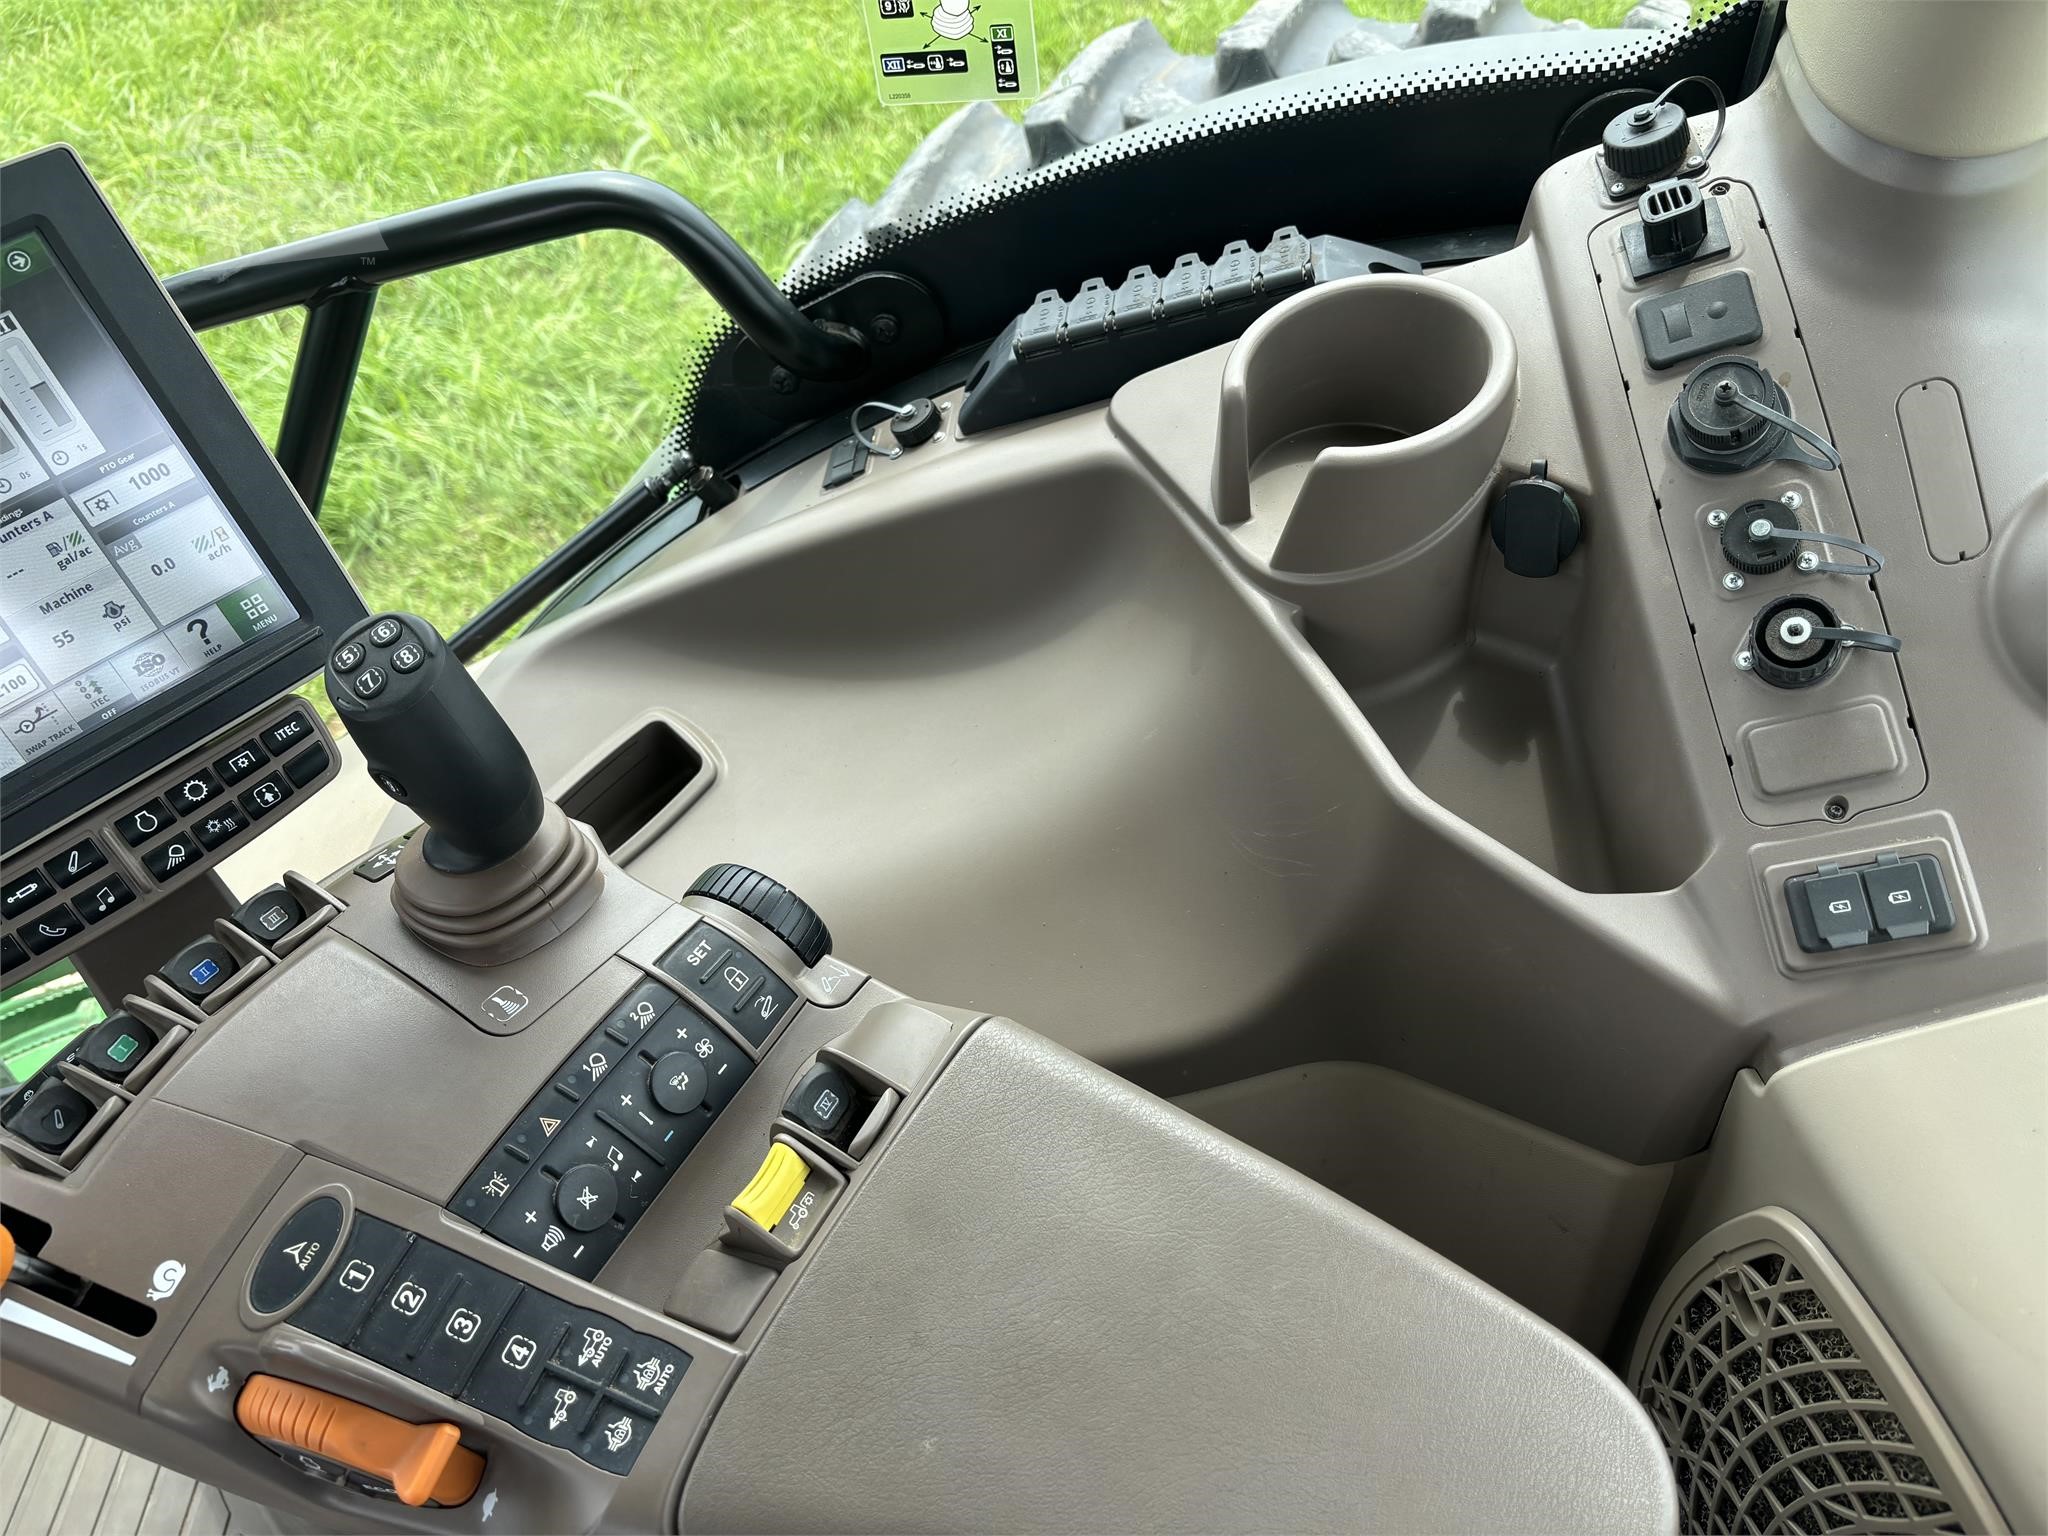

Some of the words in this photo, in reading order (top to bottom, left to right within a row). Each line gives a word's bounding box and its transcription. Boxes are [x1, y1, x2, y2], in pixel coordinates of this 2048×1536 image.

[884, 1, 892, 11] 9
[887, 60, 901, 70] XII
[99, 461, 117, 474] PTO
[117, 453, 135, 465] Gear
[19, 471, 31, 480] 0s
[128, 462, 170, 490] 1000
[42, 510, 54, 522] A
[132, 505, 168, 526] Counters
[168, 500, 176, 509] A
[113, 539, 139, 557] Avg
[207, 543, 232, 561] ac/h
[57, 546, 93, 571] gal/ac
[151, 557, 176, 577] 0.0
[39, 583, 94, 615] Machine
[113, 615, 132, 632] psi
[252, 614, 278, 632] MENU
[377, 626, 390, 638] 6
[52, 629, 75, 649] 55
[203, 643, 222, 658] HELP
[341, 650, 354, 664] 5
[400, 649, 413, 663] 8
[132, 653, 166, 677] ISO
[140, 672, 170, 692] ISOBUS
[361, 674, 374, 689] 7
[101, 707, 118, 720] OFF
[25, 739, 48, 756] SWAP
[47, 724, 76, 743] TRACK
[274, 721, 301, 742] iTEC
[686, 939, 712, 967] SET
[629, 1011, 640, 1022] 2
[582, 1064, 592, 1073] 1
[298, 1242, 320, 1271] AUTO
[348, 1268, 367, 1281] 1
[400, 1290, 421, 1309] 2
[453, 1316, 474, 1335] 3
[511, 1343, 530, 1362] 4
[591, 1336, 613, 1368] AUTO
[653, 1363, 675, 1396] AUTO
